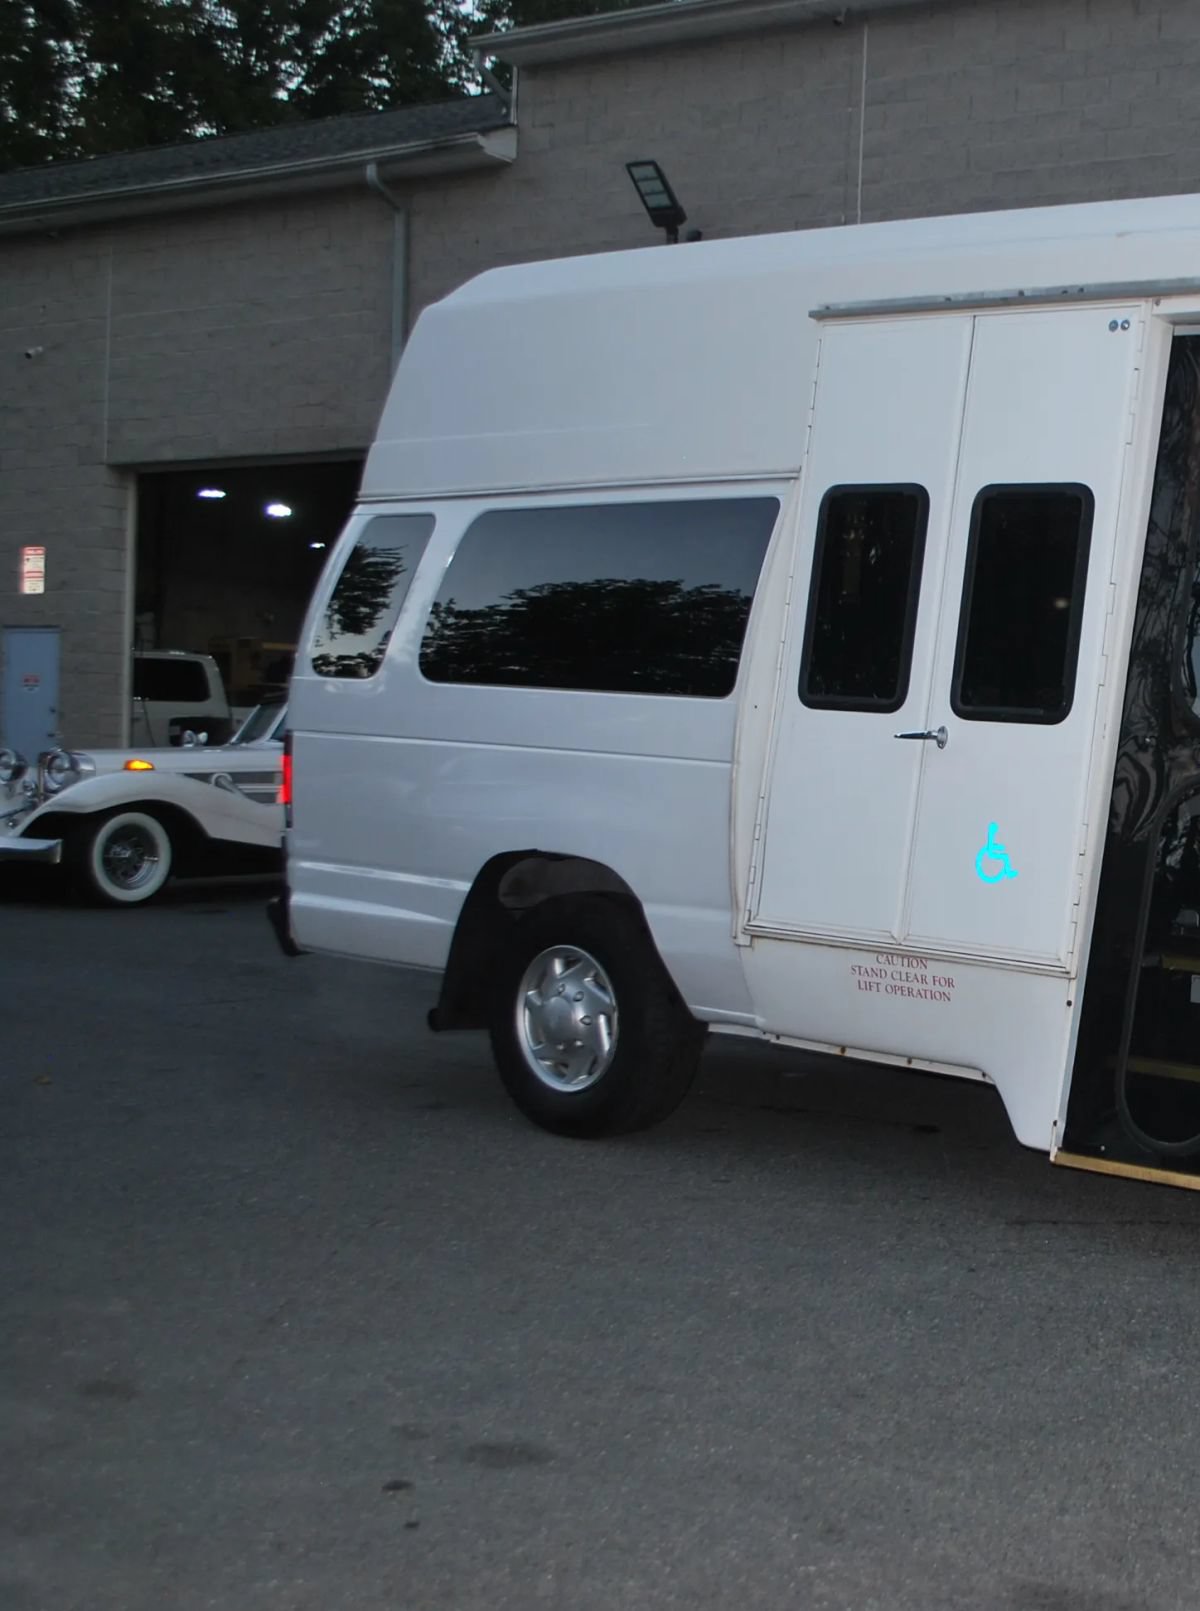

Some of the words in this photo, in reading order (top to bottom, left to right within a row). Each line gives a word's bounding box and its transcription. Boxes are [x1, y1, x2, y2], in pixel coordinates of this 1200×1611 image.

[876, 953, 928, 969] CAUTION
[850, 965, 887, 979] STAND
[891, 970, 928, 985] CLEAR
[932, 976, 955, 989] FOR
[857, 980, 881, 993] LIFT
[885, 984, 951, 1002] OPERATION
